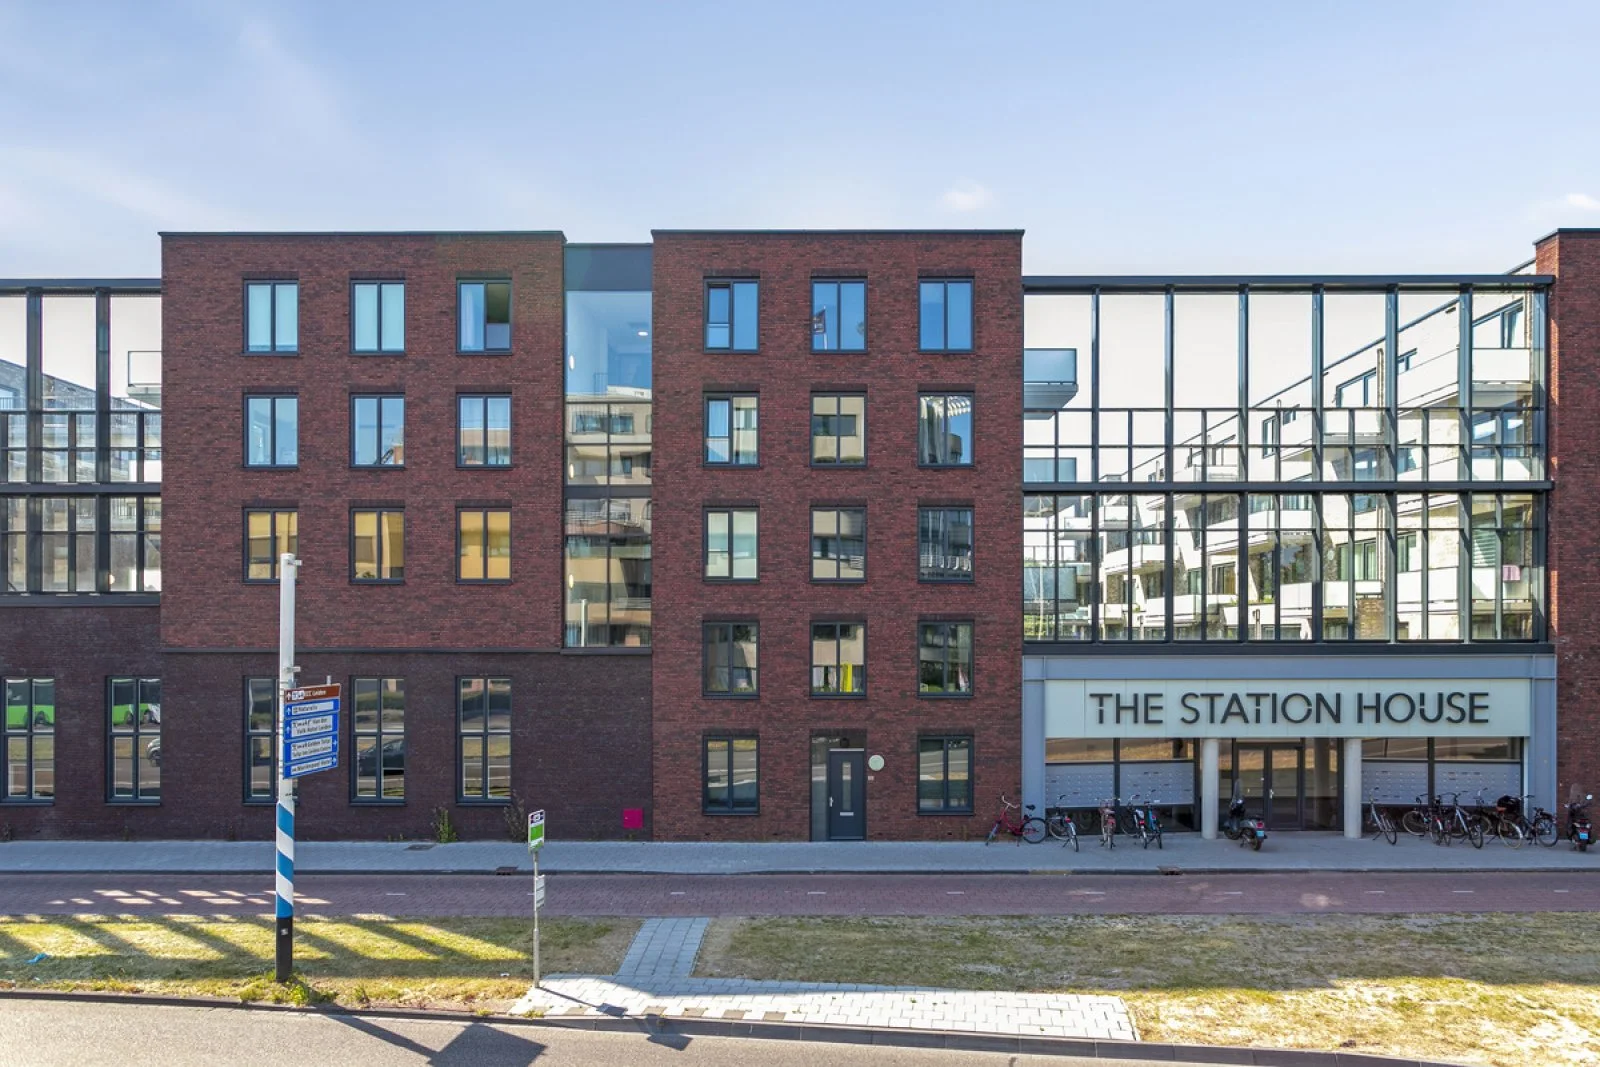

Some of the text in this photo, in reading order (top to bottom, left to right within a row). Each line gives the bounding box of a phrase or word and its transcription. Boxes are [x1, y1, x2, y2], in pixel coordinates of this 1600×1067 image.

[1089, 691, 1490, 725] THE STATION HOUSE
